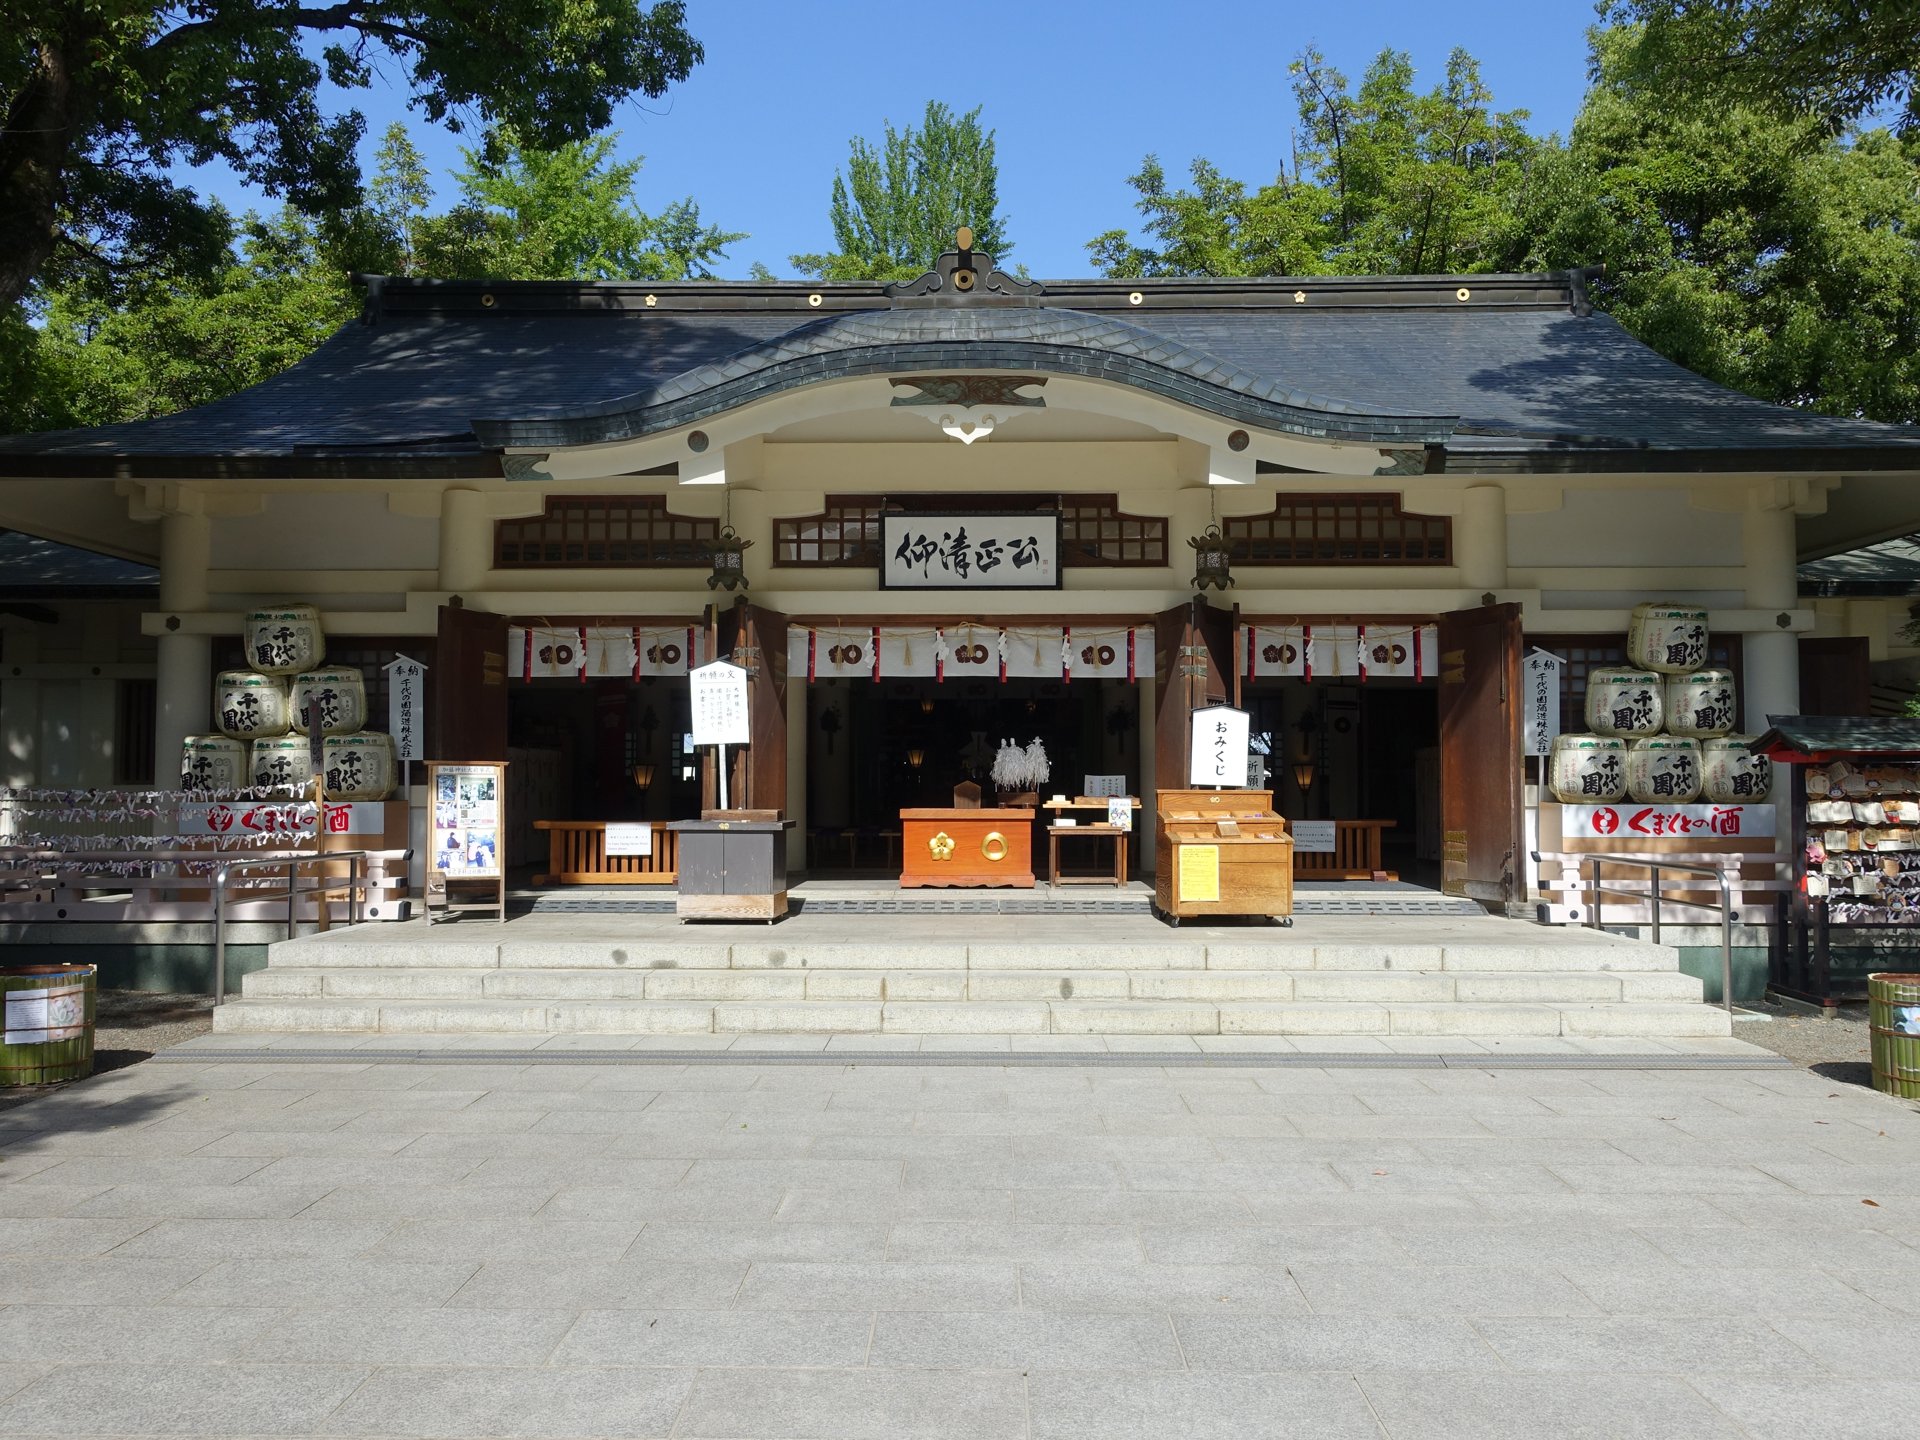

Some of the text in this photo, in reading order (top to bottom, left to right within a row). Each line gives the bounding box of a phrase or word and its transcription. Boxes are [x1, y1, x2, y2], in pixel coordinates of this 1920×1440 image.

[394, 666, 418, 677] 奉納
[1530, 660, 1555, 671] 奉納
[1536, 673, 1548, 753] 千代の園酒造株式会社
[1214, 722, 1228, 776] おみくじ
